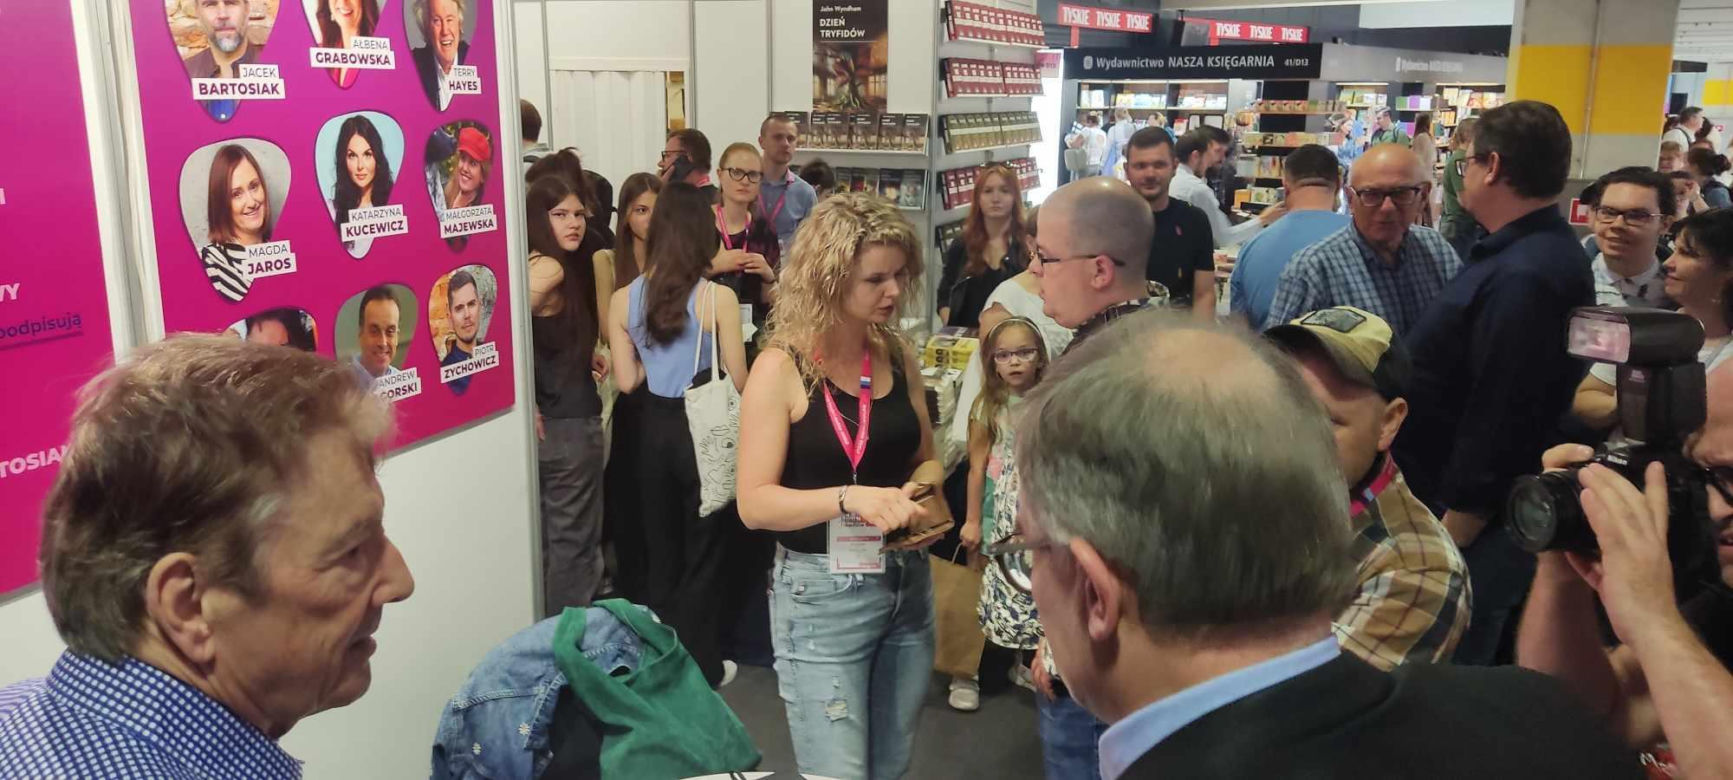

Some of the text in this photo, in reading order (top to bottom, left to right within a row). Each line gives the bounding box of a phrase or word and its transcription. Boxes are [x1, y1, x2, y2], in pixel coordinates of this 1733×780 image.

[819, 16, 846, 27] DZIEŃ
[1062, 6, 1090, 25] TYSKIE
[1096, 10, 1121, 28] TYSKIE
[1126, 13, 1149, 30] TYSKIE
[820, 27, 866, 38] TRYFIDÓW
[1216, 22, 1304, 41] TYSKIE TYSKIE TYSKIE
[315, 52, 392, 66] GRABOWSKA
[1096, 56, 1165, 71] Wydawnictwo
[1168, 56, 1204, 68] NASZA
[1207, 55, 1275, 70] KSIĘGARNIA
[242, 66, 277, 78] JACEK
[454, 67, 476, 77] TERRY
[198, 82, 281, 96] BARTOSIAK
[449, 80, 478, 91] HAYES
[351, 207, 402, 222] KATARZYNA
[346, 220, 404, 238] KUCEWICZ
[444, 218, 495, 234] MAJEWSKA
[249, 243, 289, 258] MAGDA
[247, 257, 292, 275] JAROS
[475, 344, 494, 356] PIOTR
[444, 355, 496, 379] ZYCHOWICZ
[379, 370, 416, 388] ANDREW
